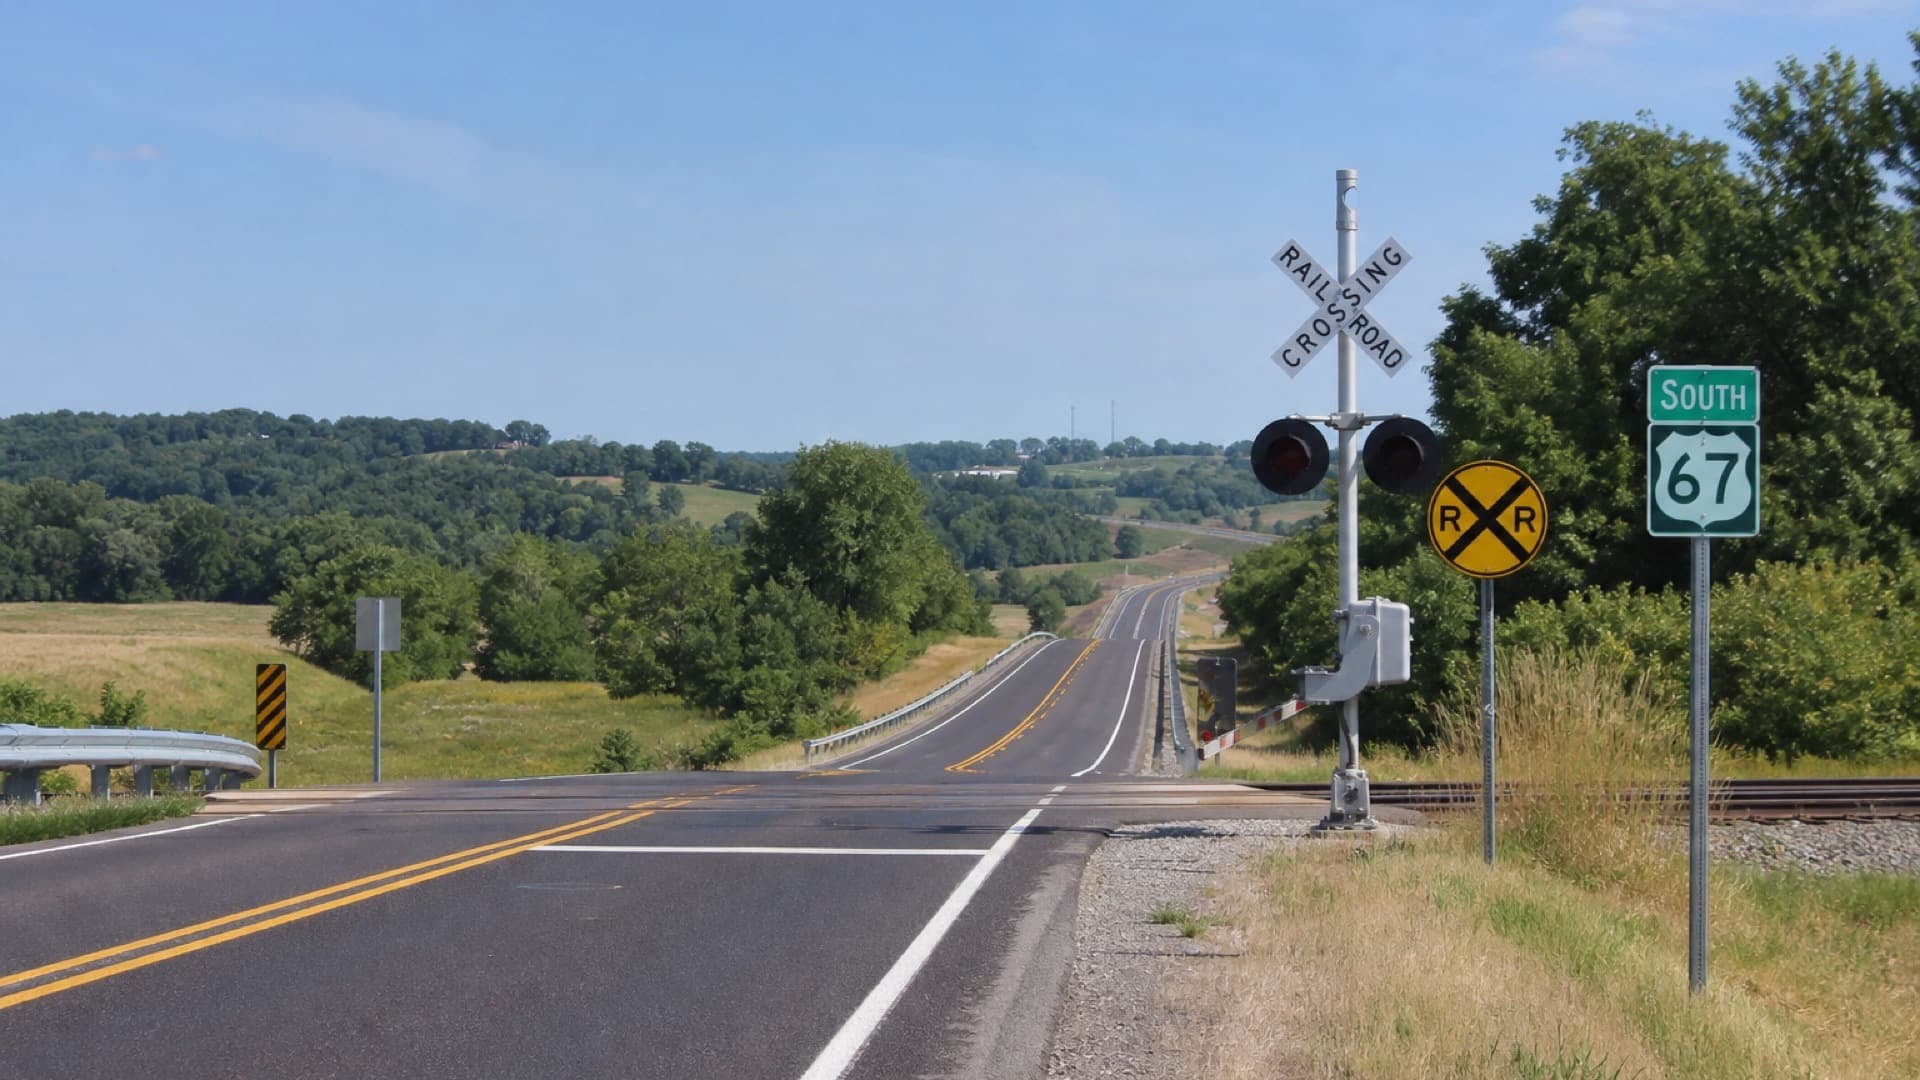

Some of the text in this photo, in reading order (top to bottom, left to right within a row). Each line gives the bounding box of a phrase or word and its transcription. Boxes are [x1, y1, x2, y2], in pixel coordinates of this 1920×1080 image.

[1281, 247, 1402, 367] CROSSING
[1660, 379, 1746, 411] SOUTH
[1667, 452, 1739, 505] 67
[1439, 505, 1536, 533] R R
